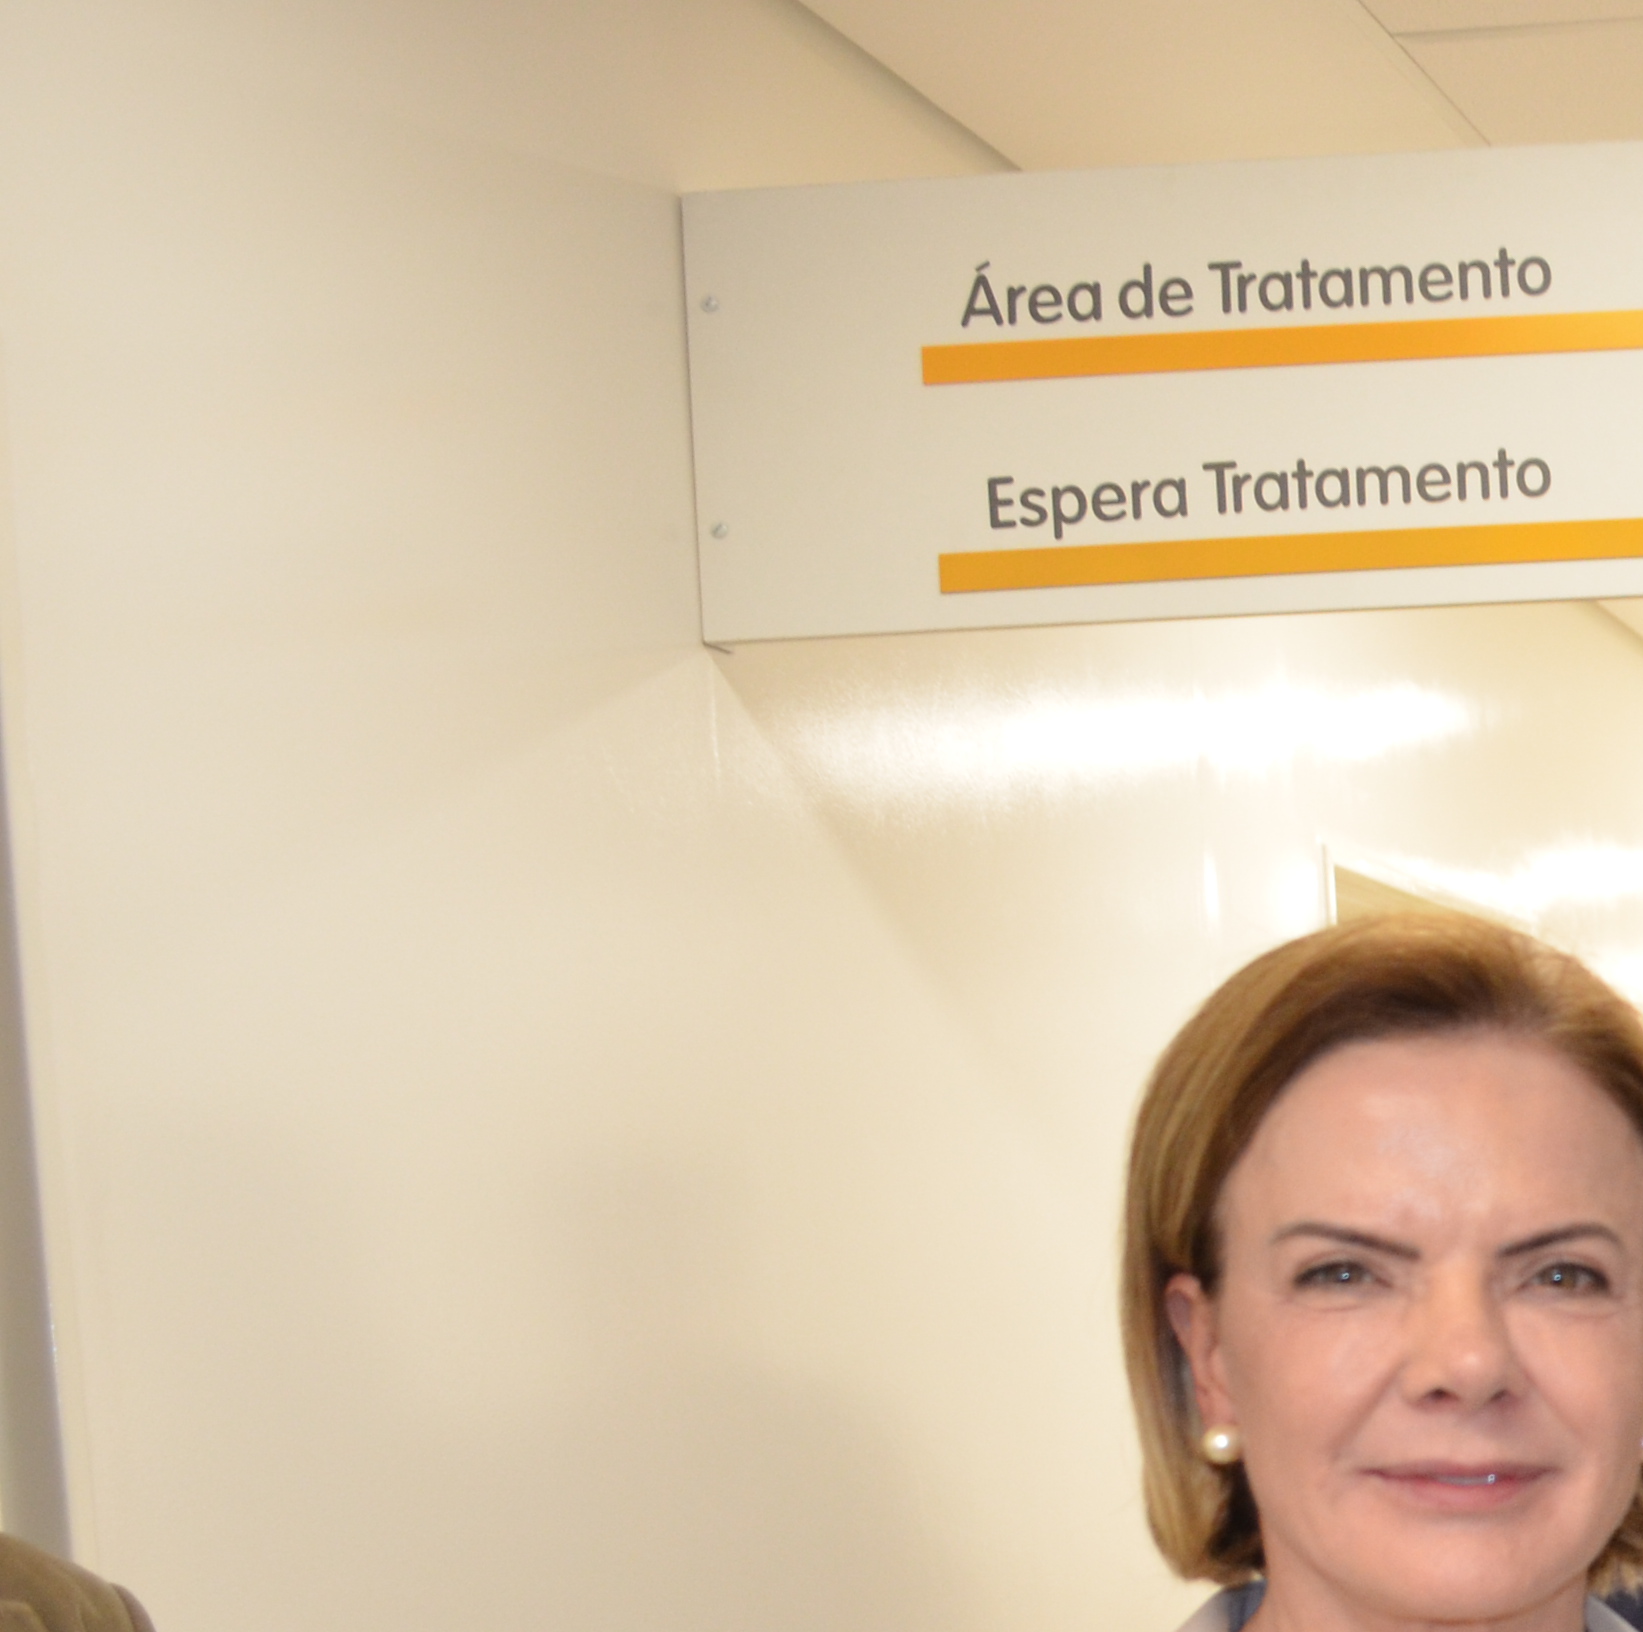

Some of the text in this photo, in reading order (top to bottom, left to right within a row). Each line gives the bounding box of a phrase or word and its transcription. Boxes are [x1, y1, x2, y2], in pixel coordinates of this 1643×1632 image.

[960, 247, 1552, 329] Área de Tratamento
[987, 448, 1552, 541] Espera Tratamento
